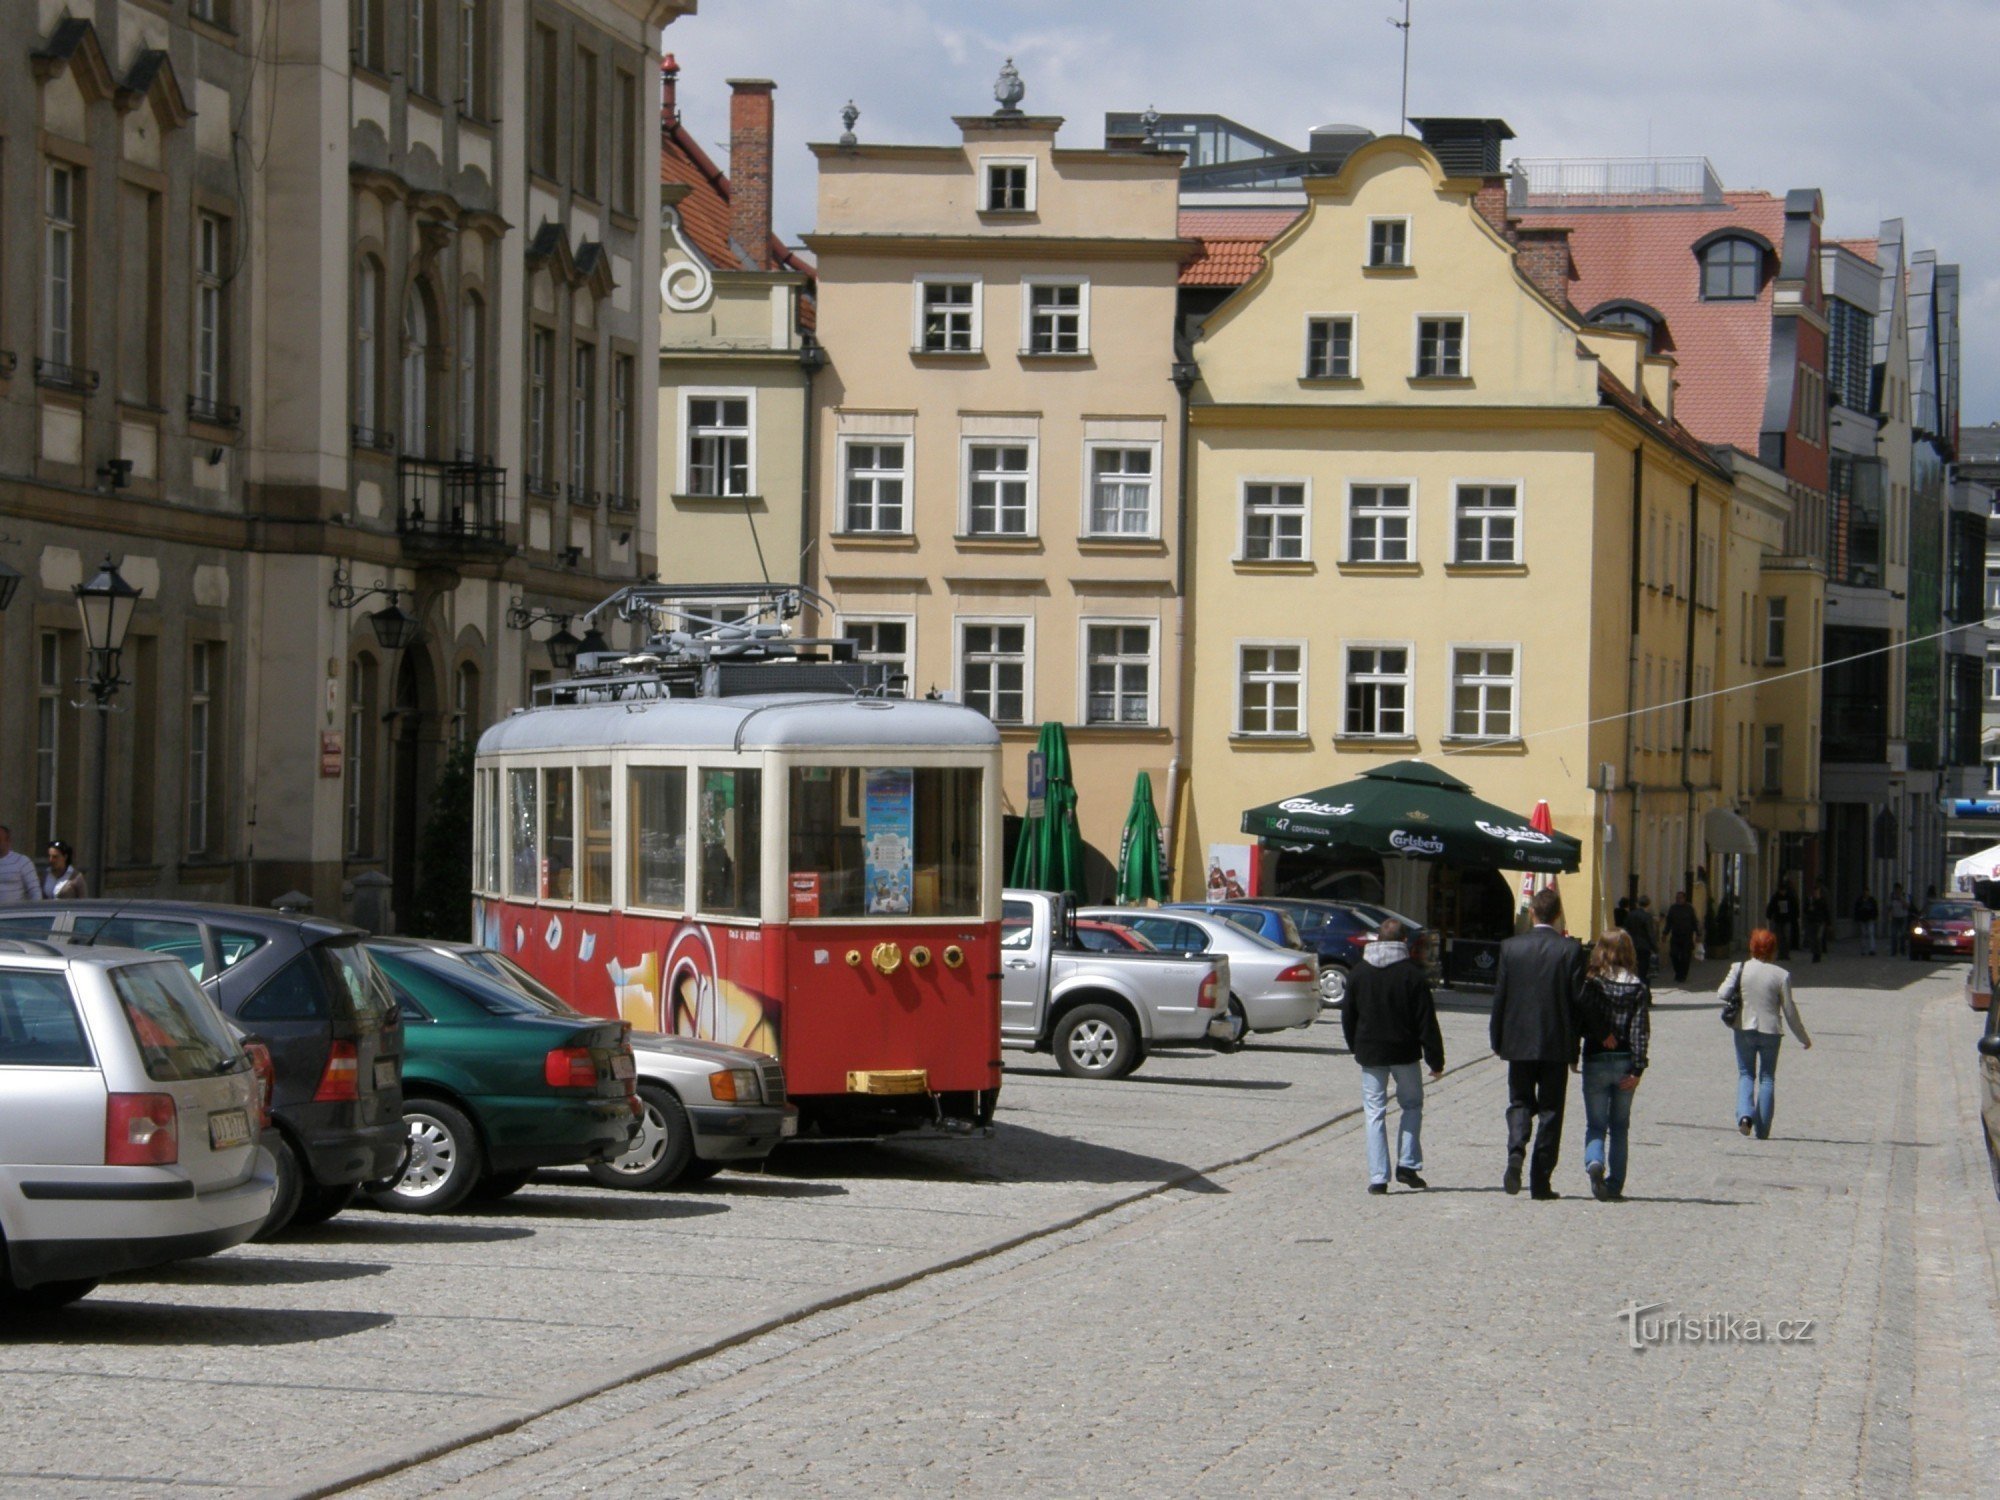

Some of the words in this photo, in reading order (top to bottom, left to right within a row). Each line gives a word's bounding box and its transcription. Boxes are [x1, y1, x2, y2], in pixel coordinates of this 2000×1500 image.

[1032, 757, 1043, 793] P
[1278, 798, 1354, 815] Carlsberg
[1266, 816, 1290, 831] 1847
[1291, 824, 1330, 835] COPENHAGEN
[1389, 830, 1444, 853] Carlsberg
